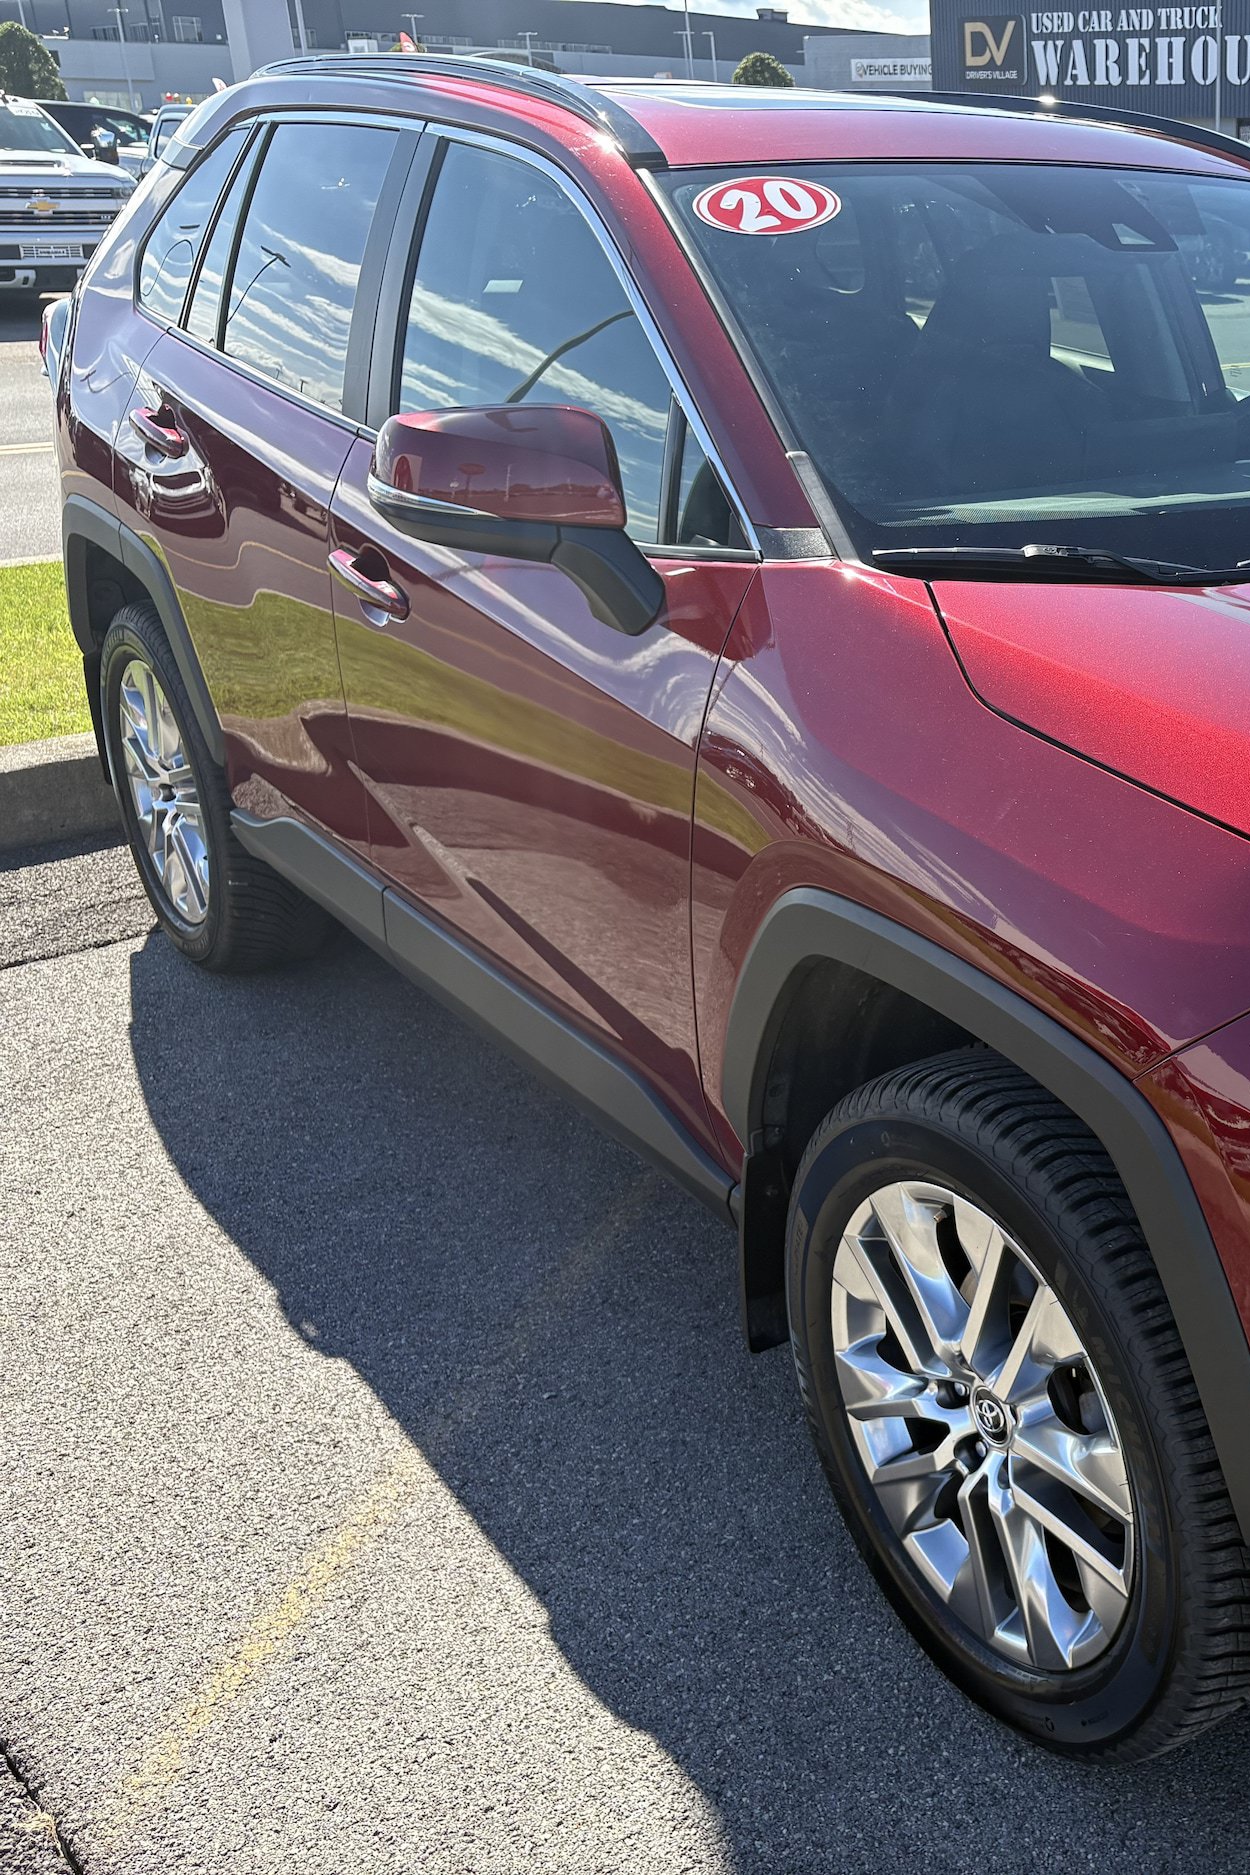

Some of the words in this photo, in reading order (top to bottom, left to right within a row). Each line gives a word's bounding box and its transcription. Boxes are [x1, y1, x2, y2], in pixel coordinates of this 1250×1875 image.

[1031, 12, 1074, 34] USED
[1078, 10, 1113, 32] CAR
[1117, 9, 1154, 31] AND
[1157, 6, 1223, 30] TRUCK
[964, 20, 1017, 67] DV
[863, 64, 899, 76] VEHICLE
[992, 70, 1018, 80] VILLAGE
[719, 180, 818, 232] 20
